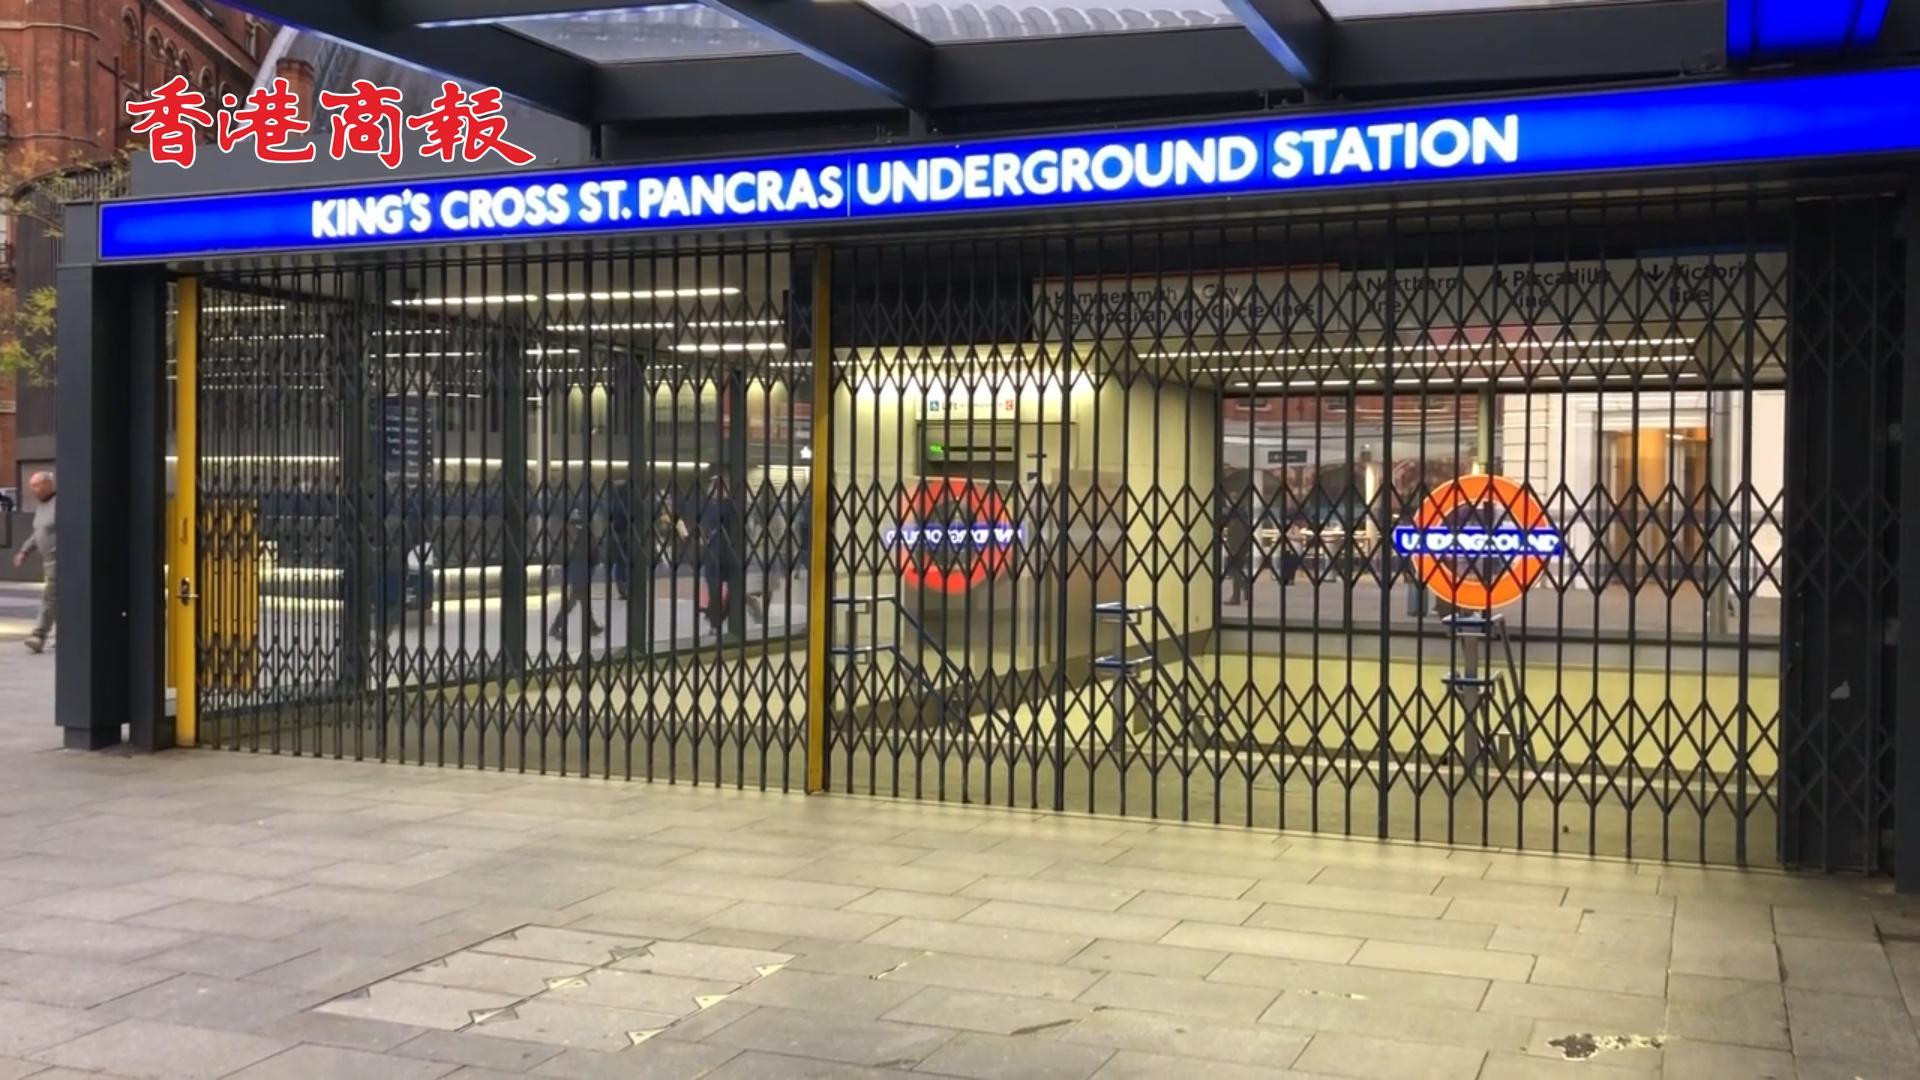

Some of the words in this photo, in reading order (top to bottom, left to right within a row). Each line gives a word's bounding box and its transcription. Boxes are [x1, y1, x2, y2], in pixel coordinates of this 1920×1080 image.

[312, 189, 431, 238] KING'S
[440, 184, 570, 230] CROSS
[579, 180, 632, 222] ST.
[639, 166, 844, 218] PANCRAS
[857, 136, 1258, 205] UNDERGROUND
[1271, 115, 1519, 178] STATION
[1514, 268, 1611, 287] Pccadill
[1671, 261, 1748, 280] Vicori
[1055, 286, 1177, 304] Hmmermh
[1203, 283, 1239, 302] Cy
[1367, 276, 1457, 292] Nrthrn
[1514, 294, 1552, 308] ine
[1056, 307, 1167, 326] erpoian
[1212, 303, 1264, 319] Cicle
[1270, 302, 1314, 317] ines
[1402, 533, 1559, 551] UDERGOUND
